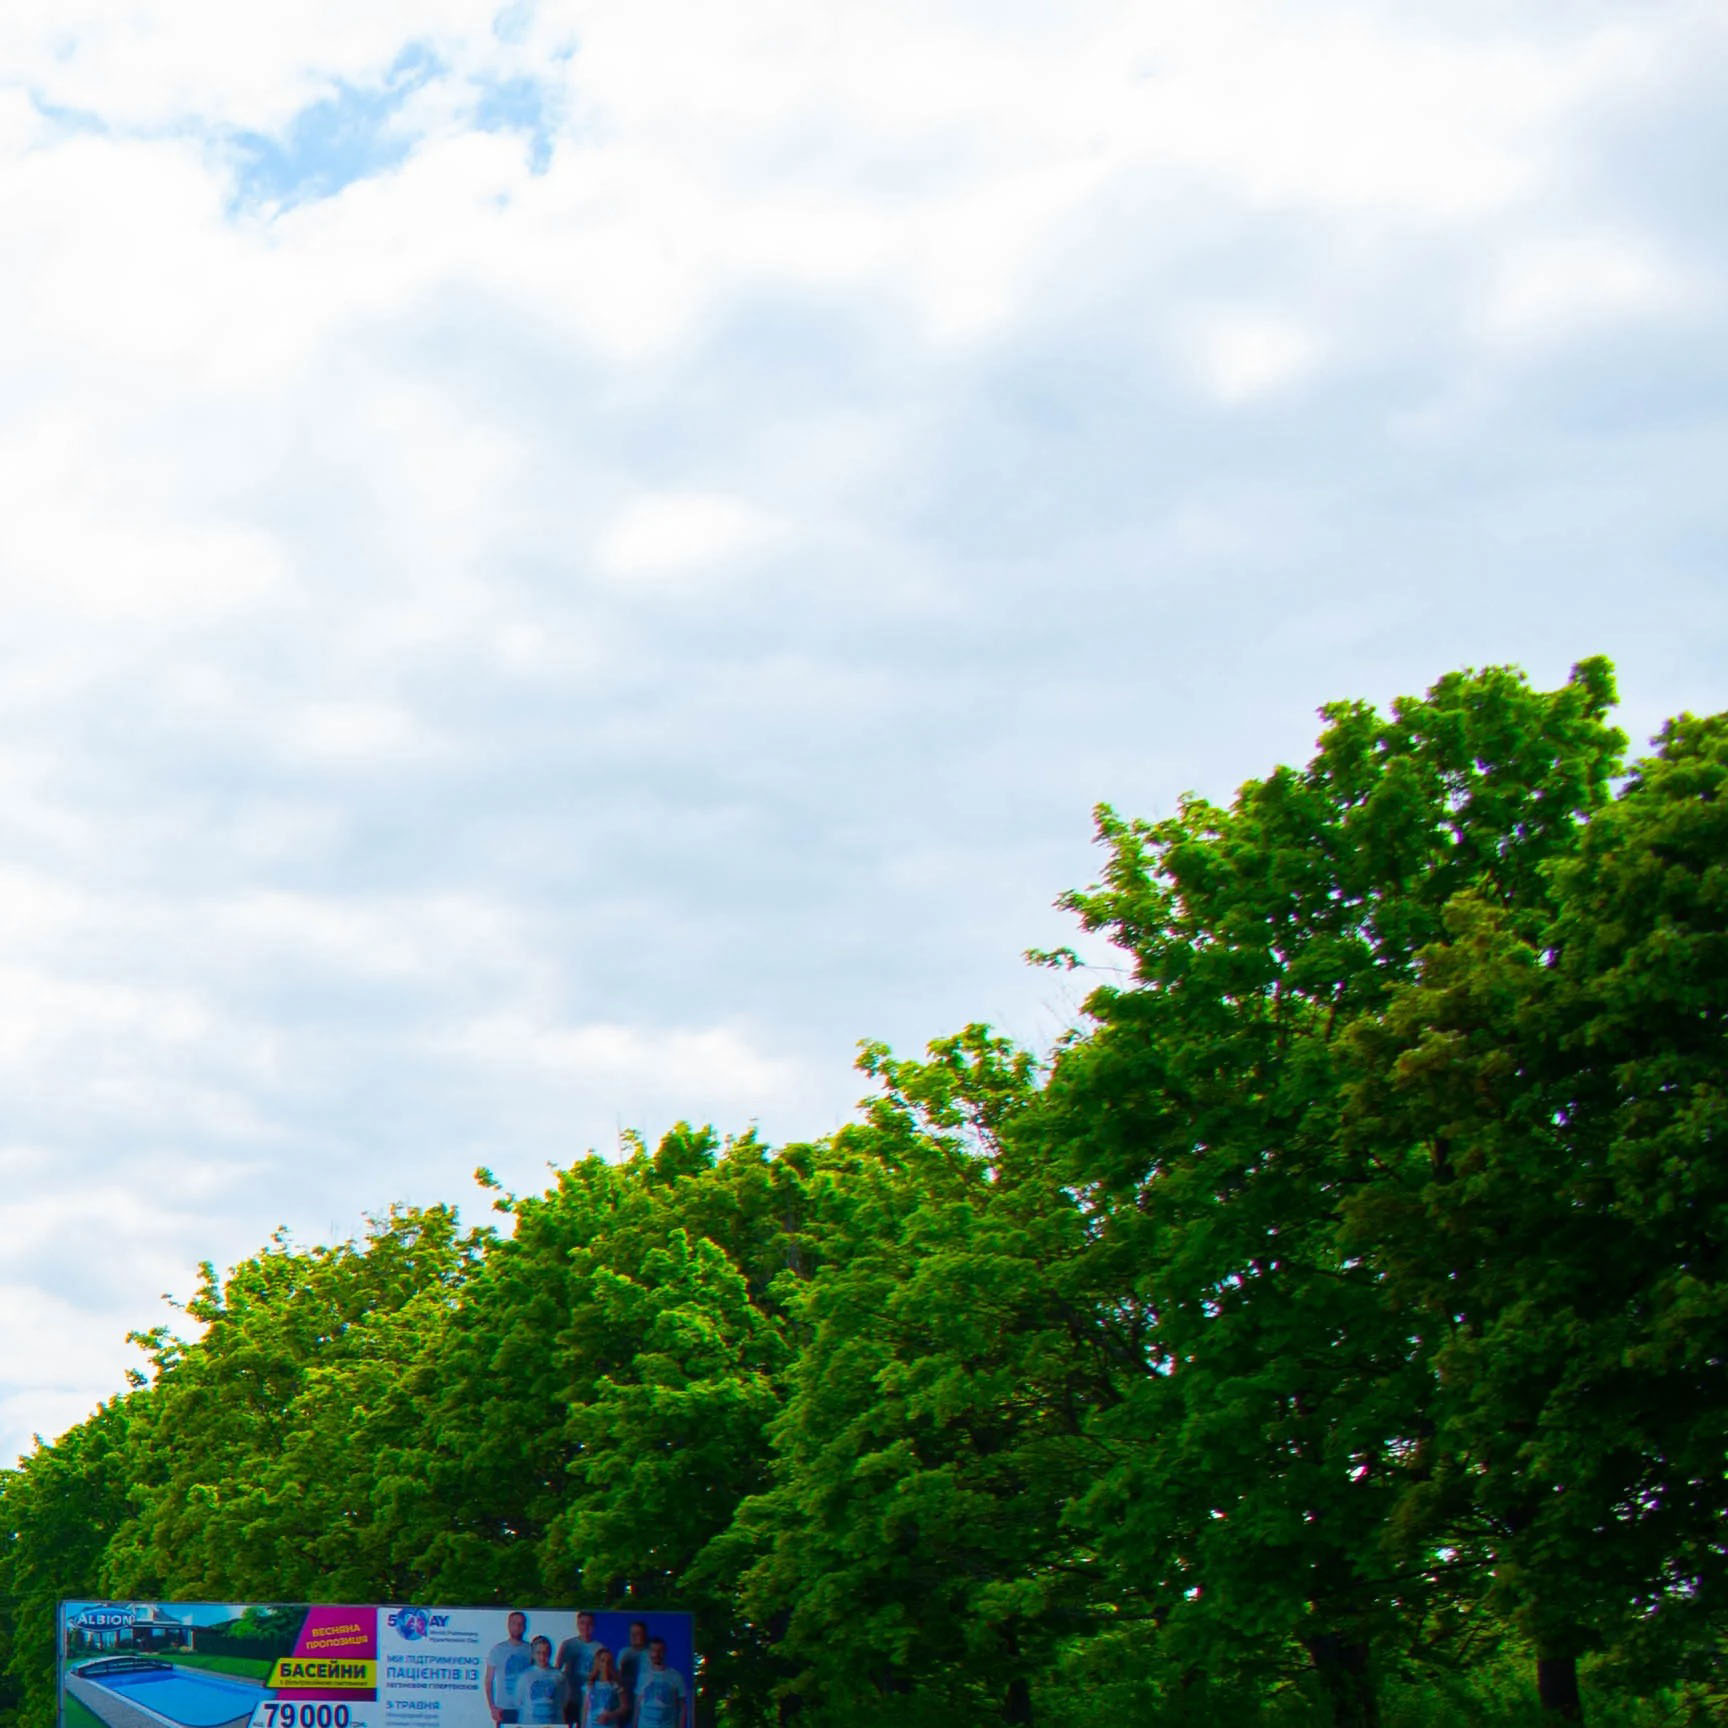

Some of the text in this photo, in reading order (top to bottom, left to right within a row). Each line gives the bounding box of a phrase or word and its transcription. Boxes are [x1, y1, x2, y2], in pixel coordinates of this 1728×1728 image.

[77, 1613, 134, 1626] ALBION
[311, 1623, 361, 1637] ВЕСНЯНА
[280, 1659, 366, 1679] БАСЕЙНИ
[387, 1667, 460, 1680] ПАЦІЄНТІВ
[396, 1700, 440, 1710] ТРАВНЯ
